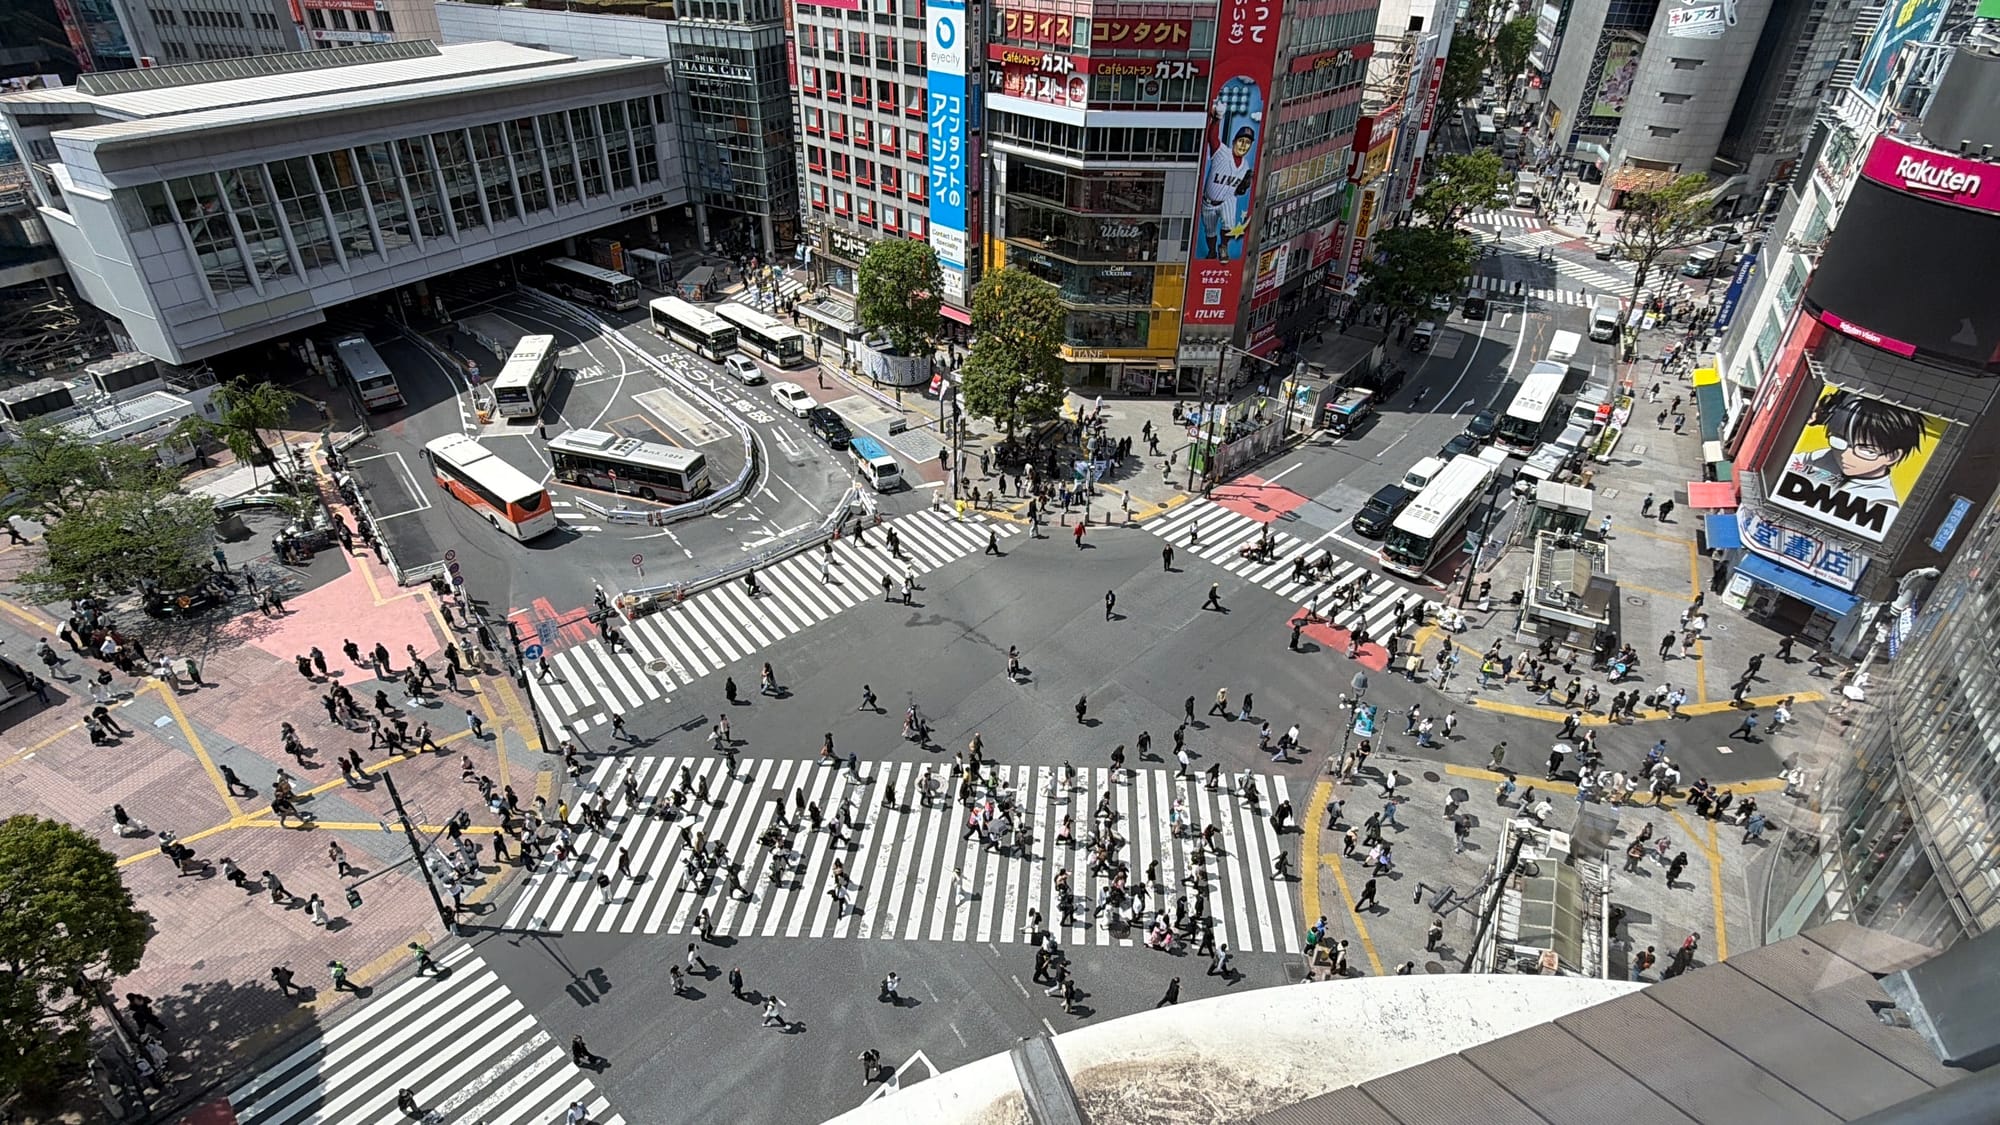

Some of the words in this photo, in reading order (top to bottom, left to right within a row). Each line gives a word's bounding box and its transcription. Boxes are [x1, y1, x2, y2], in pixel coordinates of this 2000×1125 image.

[1250, 0, 1272, 43] って
[1672, 7, 1719, 24] キルアオ
[1092, 22, 1187, 43] コンタクト
[679, 61, 715, 73] MARK
[720, 65, 751, 77] CITY
[694, 54, 730, 65] SHIBUYA
[931, 52, 960, 68] eyecity
[1041, 54, 1074, 75] ガスト
[1155, 60, 1199, 79] ガスト
[931, 92, 947, 204] アイシティ
[949, 96, 960, 208] コンタクトの
[1895, 155, 1981, 195] Rakuten
[833, 233, 870, 258] サンドラ
[1303, 265, 1325, 289] LUSH
[1195, 309, 1225, 319] 17LIVE
[1791, 458, 1841, 486] キルアオ
[1776, 471, 1889, 534] DMM
